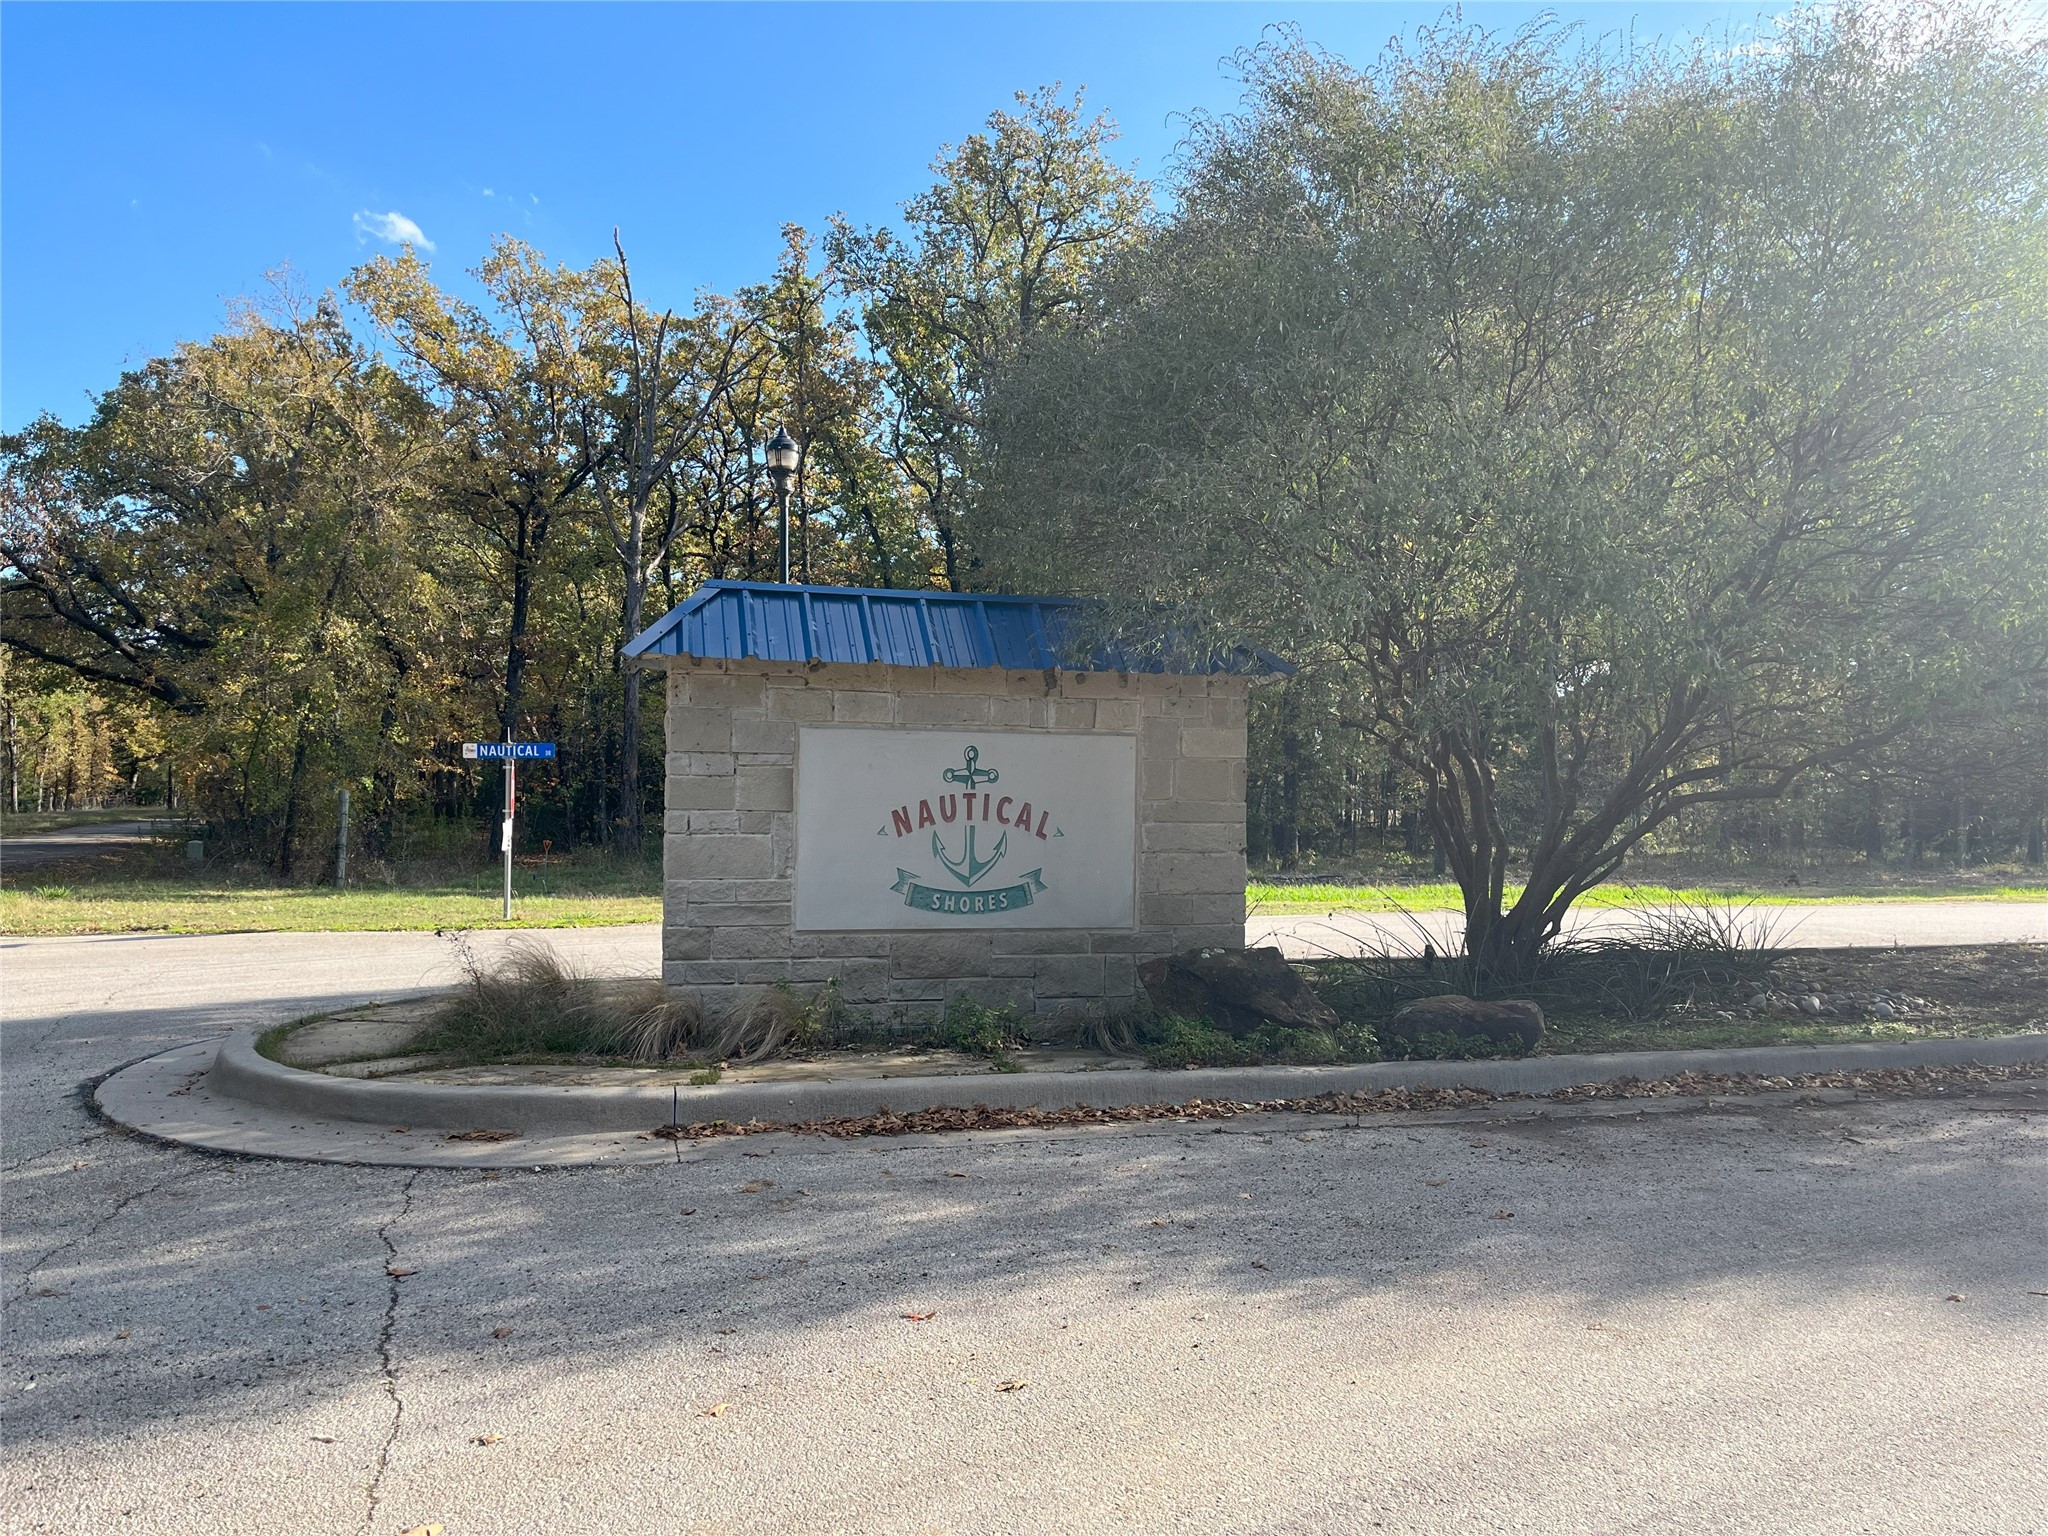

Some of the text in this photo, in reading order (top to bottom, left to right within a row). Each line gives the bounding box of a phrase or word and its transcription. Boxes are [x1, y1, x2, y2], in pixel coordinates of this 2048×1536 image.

[479, 745, 540, 756] NAUTICAL
[891, 792, 1049, 840] NAUTICAL
[931, 892, 1008, 912] SHORES
